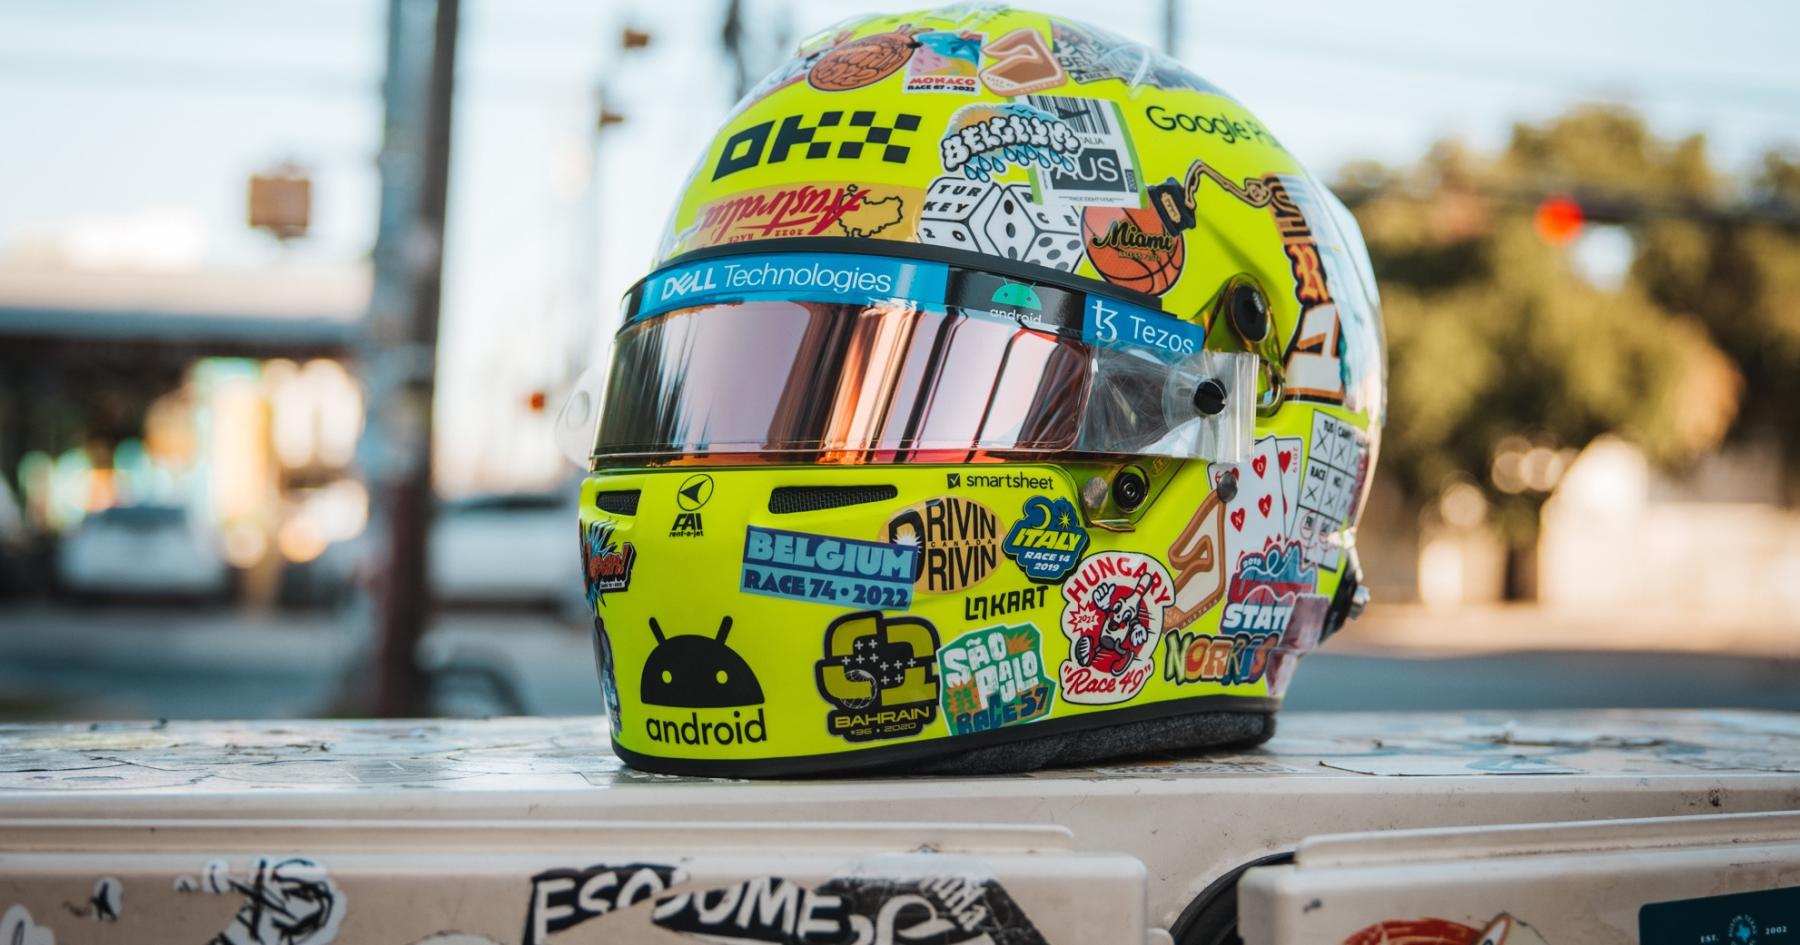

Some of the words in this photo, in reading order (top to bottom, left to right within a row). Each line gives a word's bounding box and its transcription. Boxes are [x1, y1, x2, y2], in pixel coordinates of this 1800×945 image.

[909, 76, 976, 86] MONACO
[1146, 106, 1250, 144] Google
[941, 114, 1081, 172] BELGIUM
[938, 184, 982, 197] TUR
[699, 184, 872, 244] Australia
[923, 201, 969, 213] KEY
[1091, 220, 1176, 251] Miami
[661, 266, 717, 301] DELL
[724, 263, 891, 294] Technologies
[989, 307, 1042, 325] android
[1129, 315, 1194, 354] Tezos
[966, 472, 1054, 490] smartsheet
[672, 513, 702, 530] FAI
[930, 538, 993, 547] CANADA
[1012, 527, 1082, 551] ITALY
[749, 530, 914, 578] BELGIUM
[1024, 551, 1056, 562] RACE
[1058, 554, 1071, 563] 14
[1033, 562, 1061, 572] 2019
[743, 568, 807, 596] RACE
[808, 577, 836, 600] 74
[854, 584, 909, 608] 2022
[1067, 556, 1173, 605] HUNGARY
[943, 632, 1007, 688] SÃO
[645, 708, 768, 746] android
[834, 706, 931, 729] BAHRAIN
[883, 722, 917, 733] 2020
